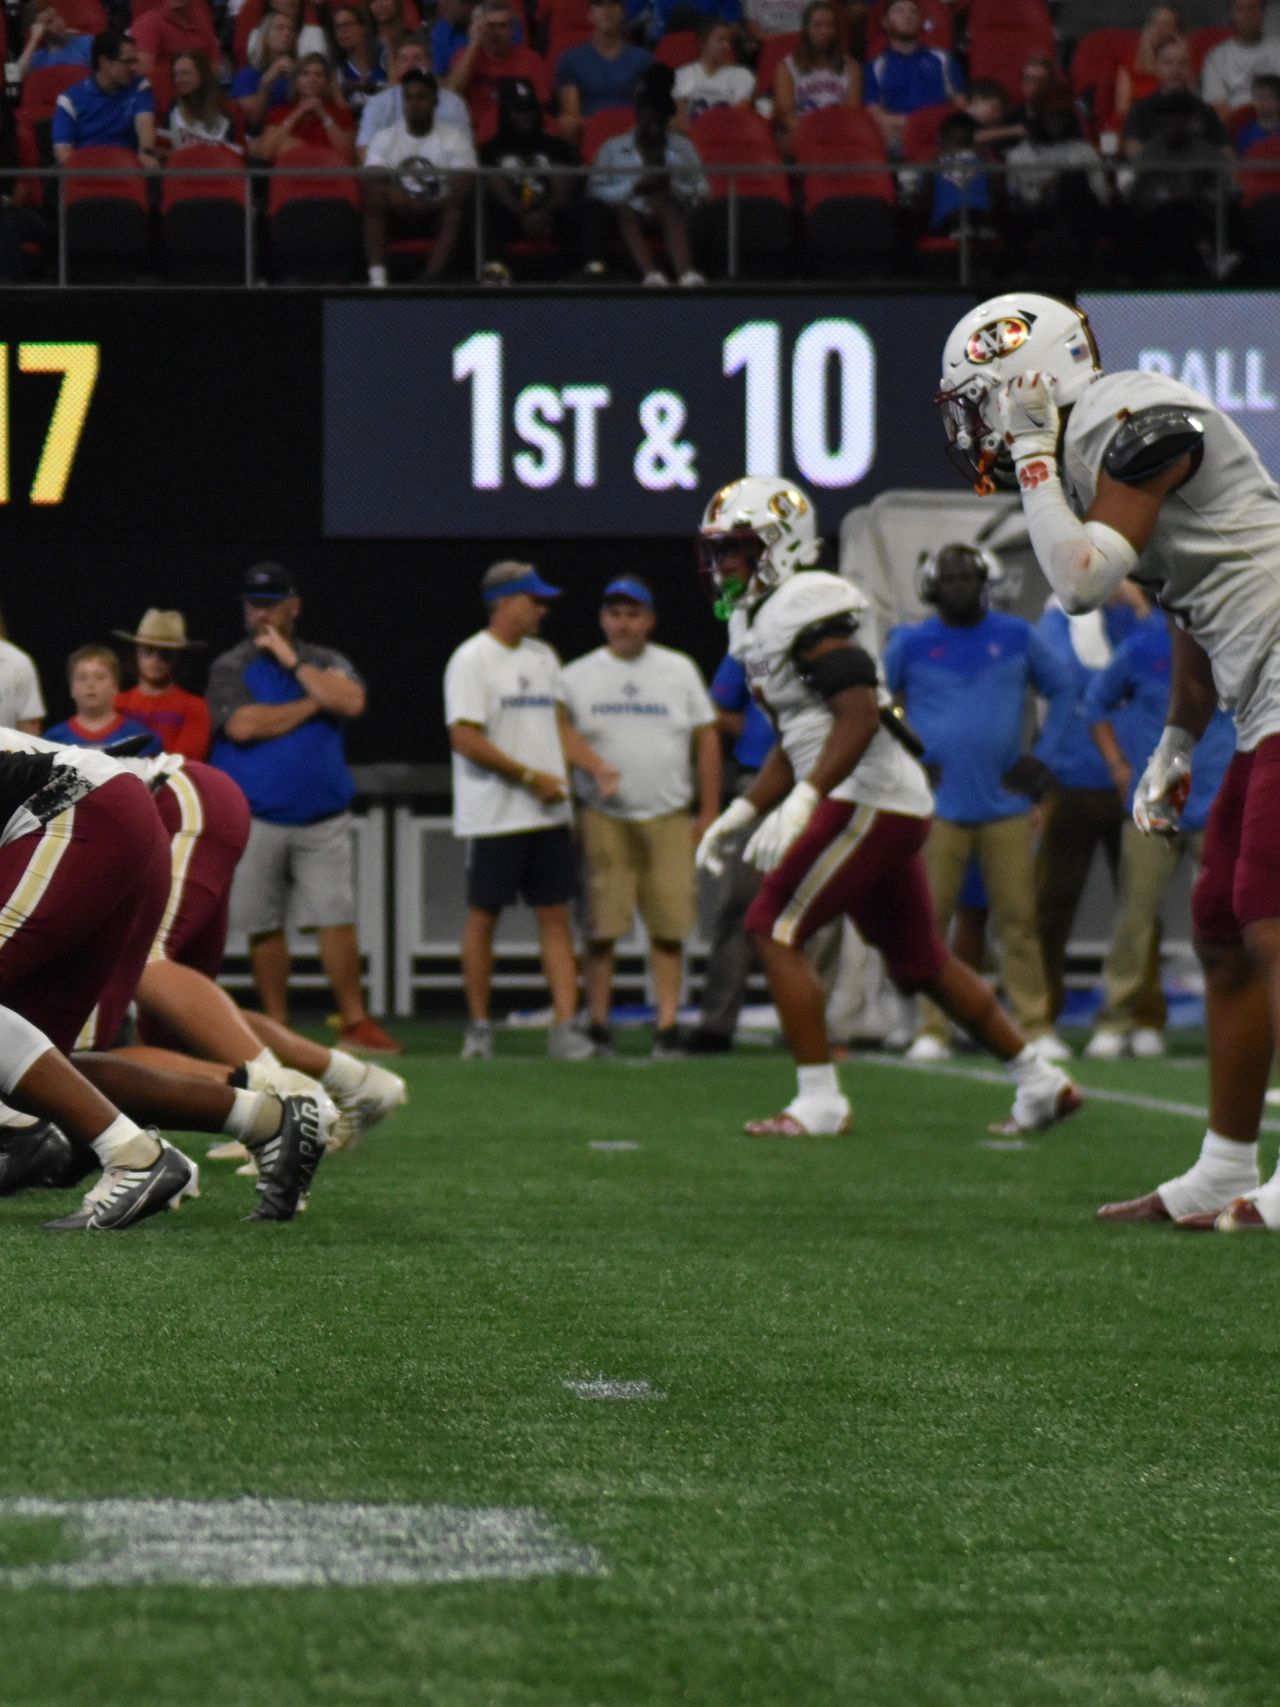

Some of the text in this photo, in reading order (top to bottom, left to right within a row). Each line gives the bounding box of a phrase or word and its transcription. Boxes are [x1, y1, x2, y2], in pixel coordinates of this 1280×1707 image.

[452, 317, 878, 490] 1ST & 10
